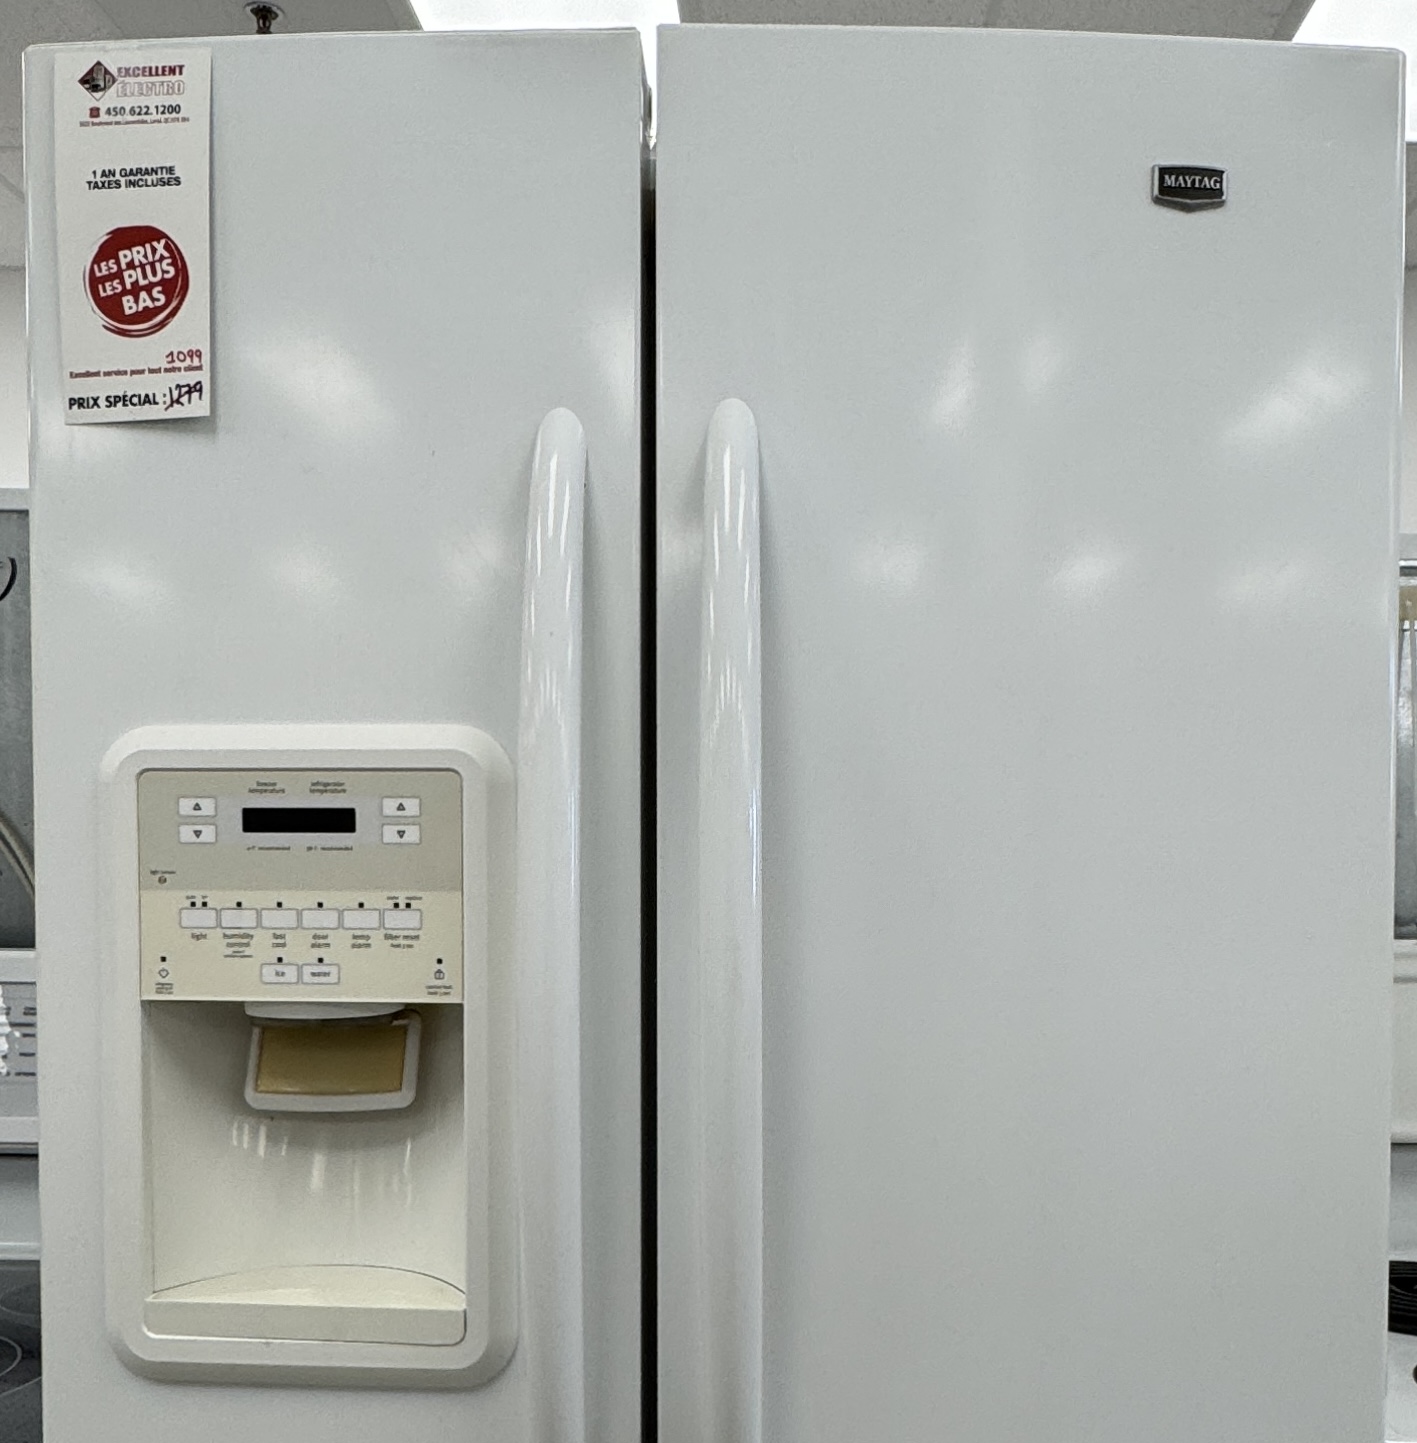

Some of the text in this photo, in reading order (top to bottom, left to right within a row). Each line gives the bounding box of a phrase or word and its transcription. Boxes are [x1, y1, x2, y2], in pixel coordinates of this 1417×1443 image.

[116, 64, 185, 78] EXCELLENT
[105, 103, 182, 117] 450.622.1200
[91, 165, 176, 179] 1 AN GARANTIE
[86, 176, 182, 190] TAXES INCLUSES
[1163, 174, 1221, 190] MAYTAG
[94, 238, 171, 278] LES PRIX
[98, 258, 176, 298] LES PLUS
[121, 286, 167, 316] BAS
[165, 349, 203, 364] 1099
[68, 395, 101, 411] PRIX
[105, 389, 160, 409] SPÉCIAL
[274, 968, 286, 977] ice
